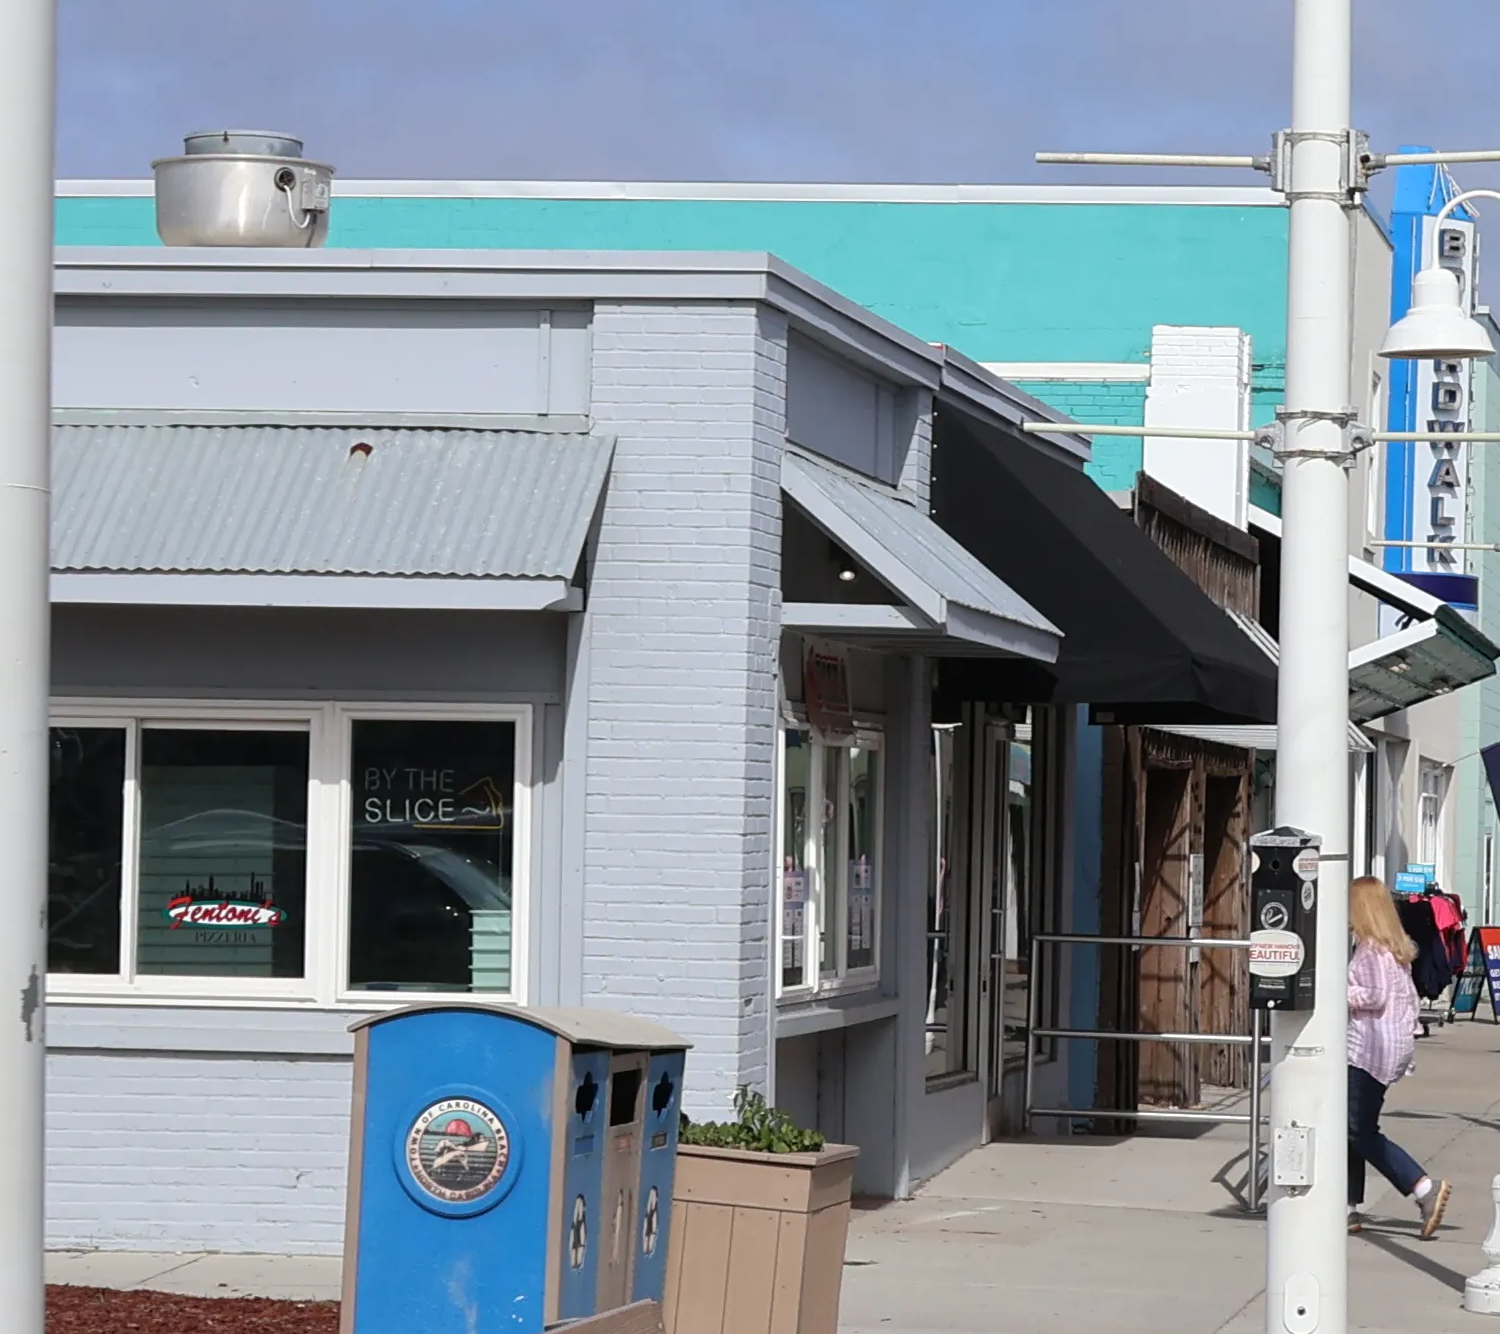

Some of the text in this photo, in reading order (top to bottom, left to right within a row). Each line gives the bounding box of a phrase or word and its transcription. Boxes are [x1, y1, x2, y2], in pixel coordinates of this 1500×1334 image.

[364, 768, 455, 792] BY THE
[364, 797, 455, 823] SLICE
[166, 895, 282, 929] Fentoni's
[410, 1101, 507, 1167] TOWN OF CAROLINA BEACH
